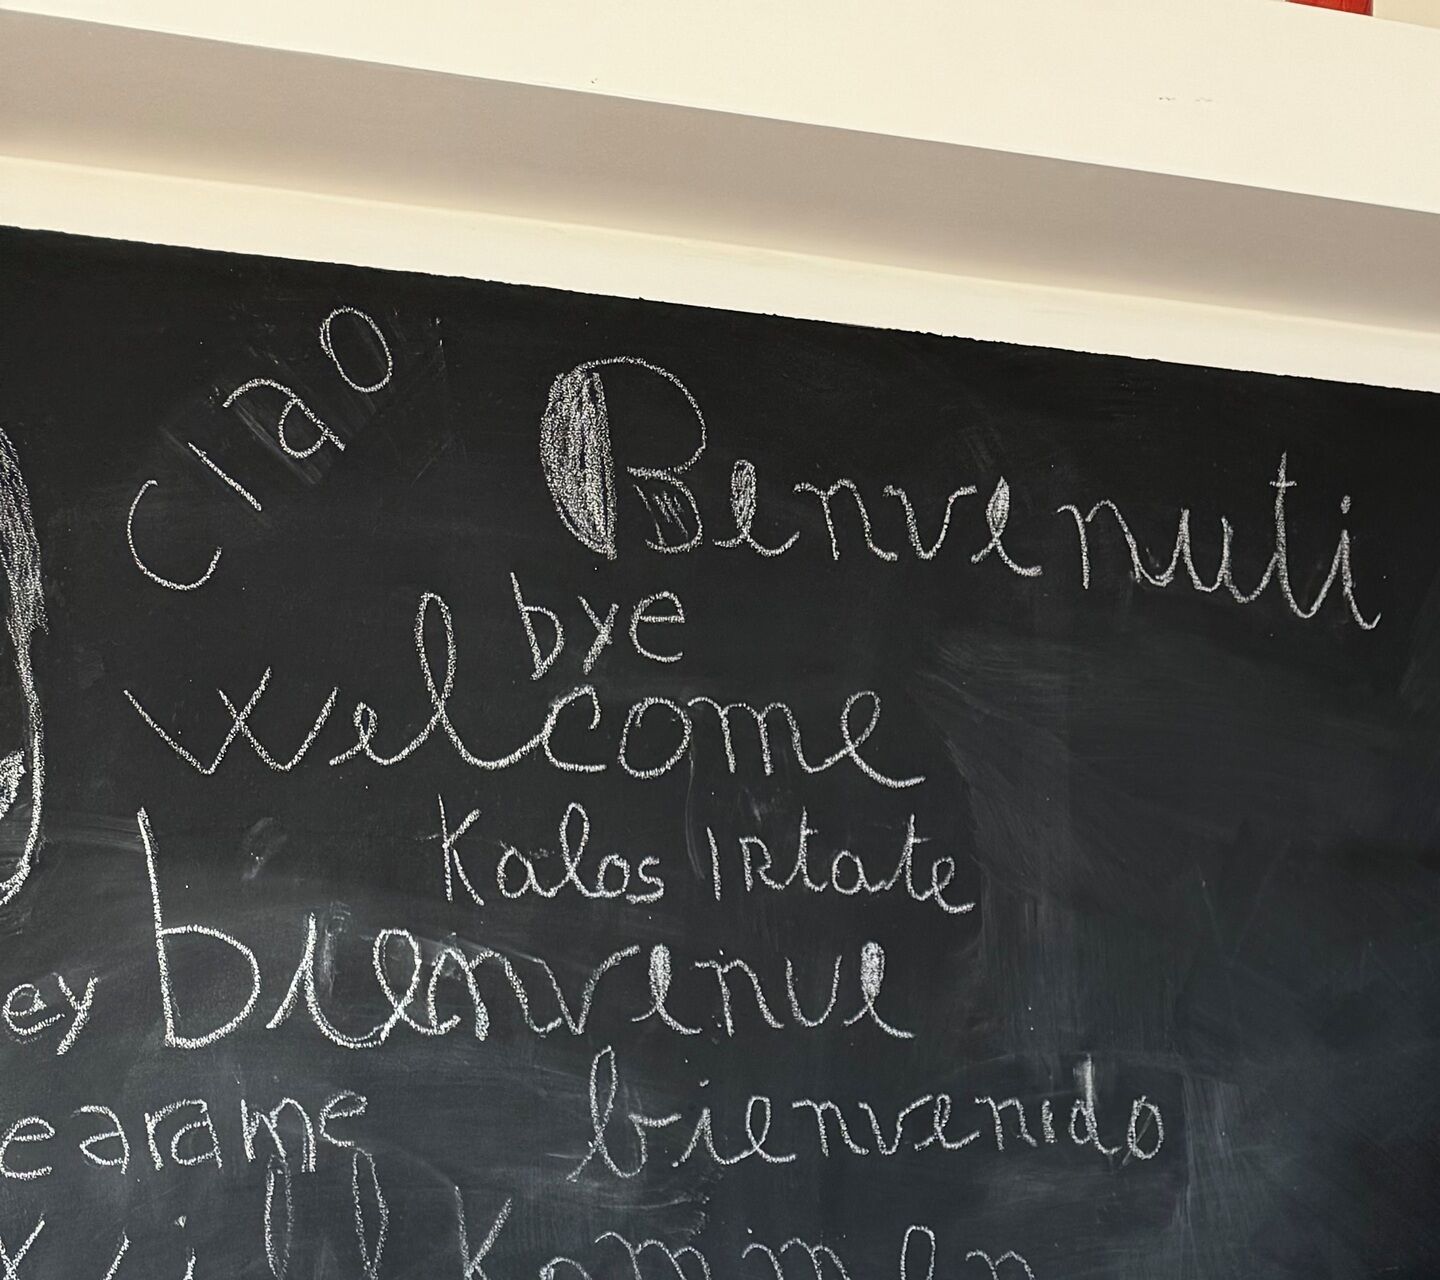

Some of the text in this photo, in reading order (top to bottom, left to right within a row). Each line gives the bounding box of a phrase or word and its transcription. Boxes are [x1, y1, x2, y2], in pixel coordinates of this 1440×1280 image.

[538, 355, 1383, 630] Benvenuti
[510, 571, 687, 681] bye
[437, 794, 666, 905] Kalos
[565, 1045, 1166, 1182] bienvenido
